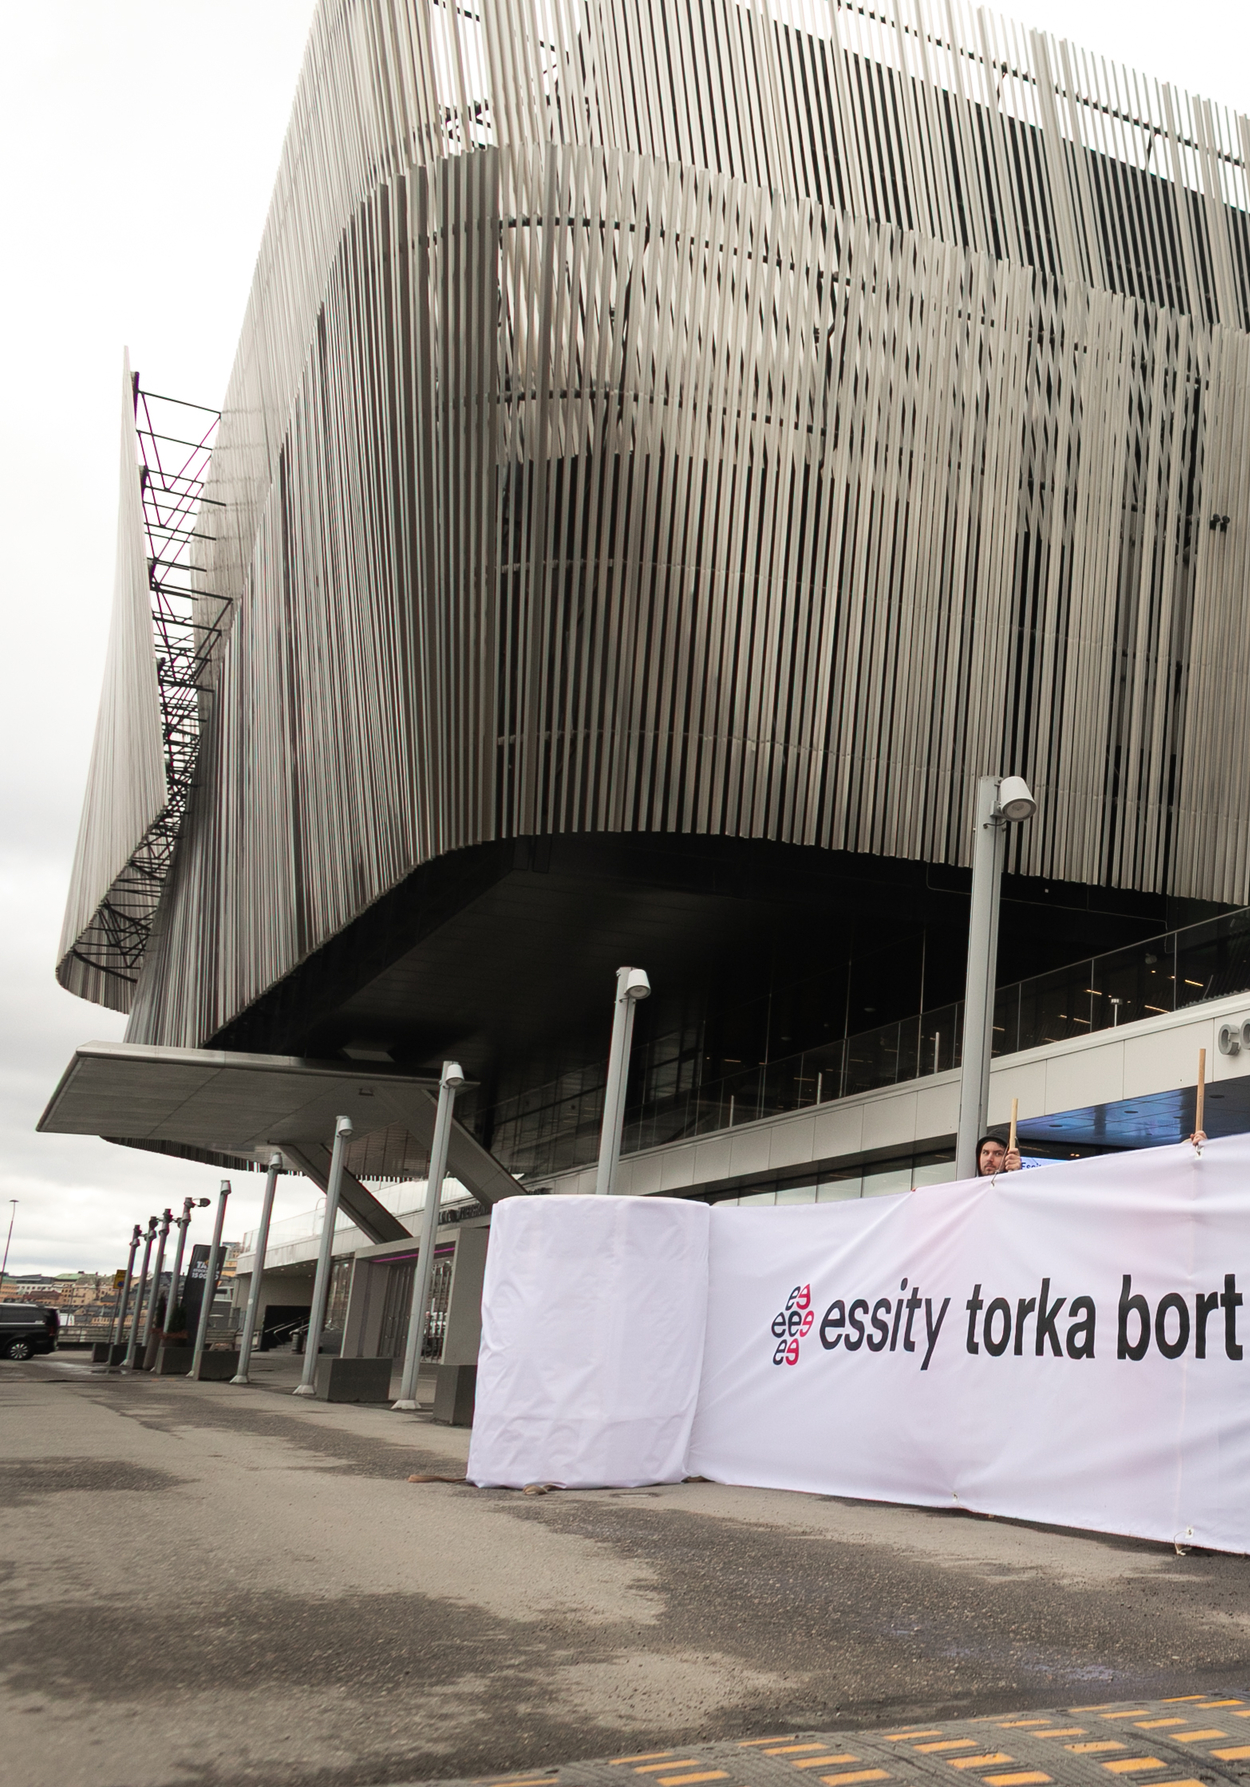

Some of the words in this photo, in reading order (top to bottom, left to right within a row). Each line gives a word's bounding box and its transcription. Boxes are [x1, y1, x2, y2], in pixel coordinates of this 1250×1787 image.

[819, 1277, 951, 1371] essity
[965, 1277, 1096, 1360] torka
[1116, 1273, 1244, 1362] bort
